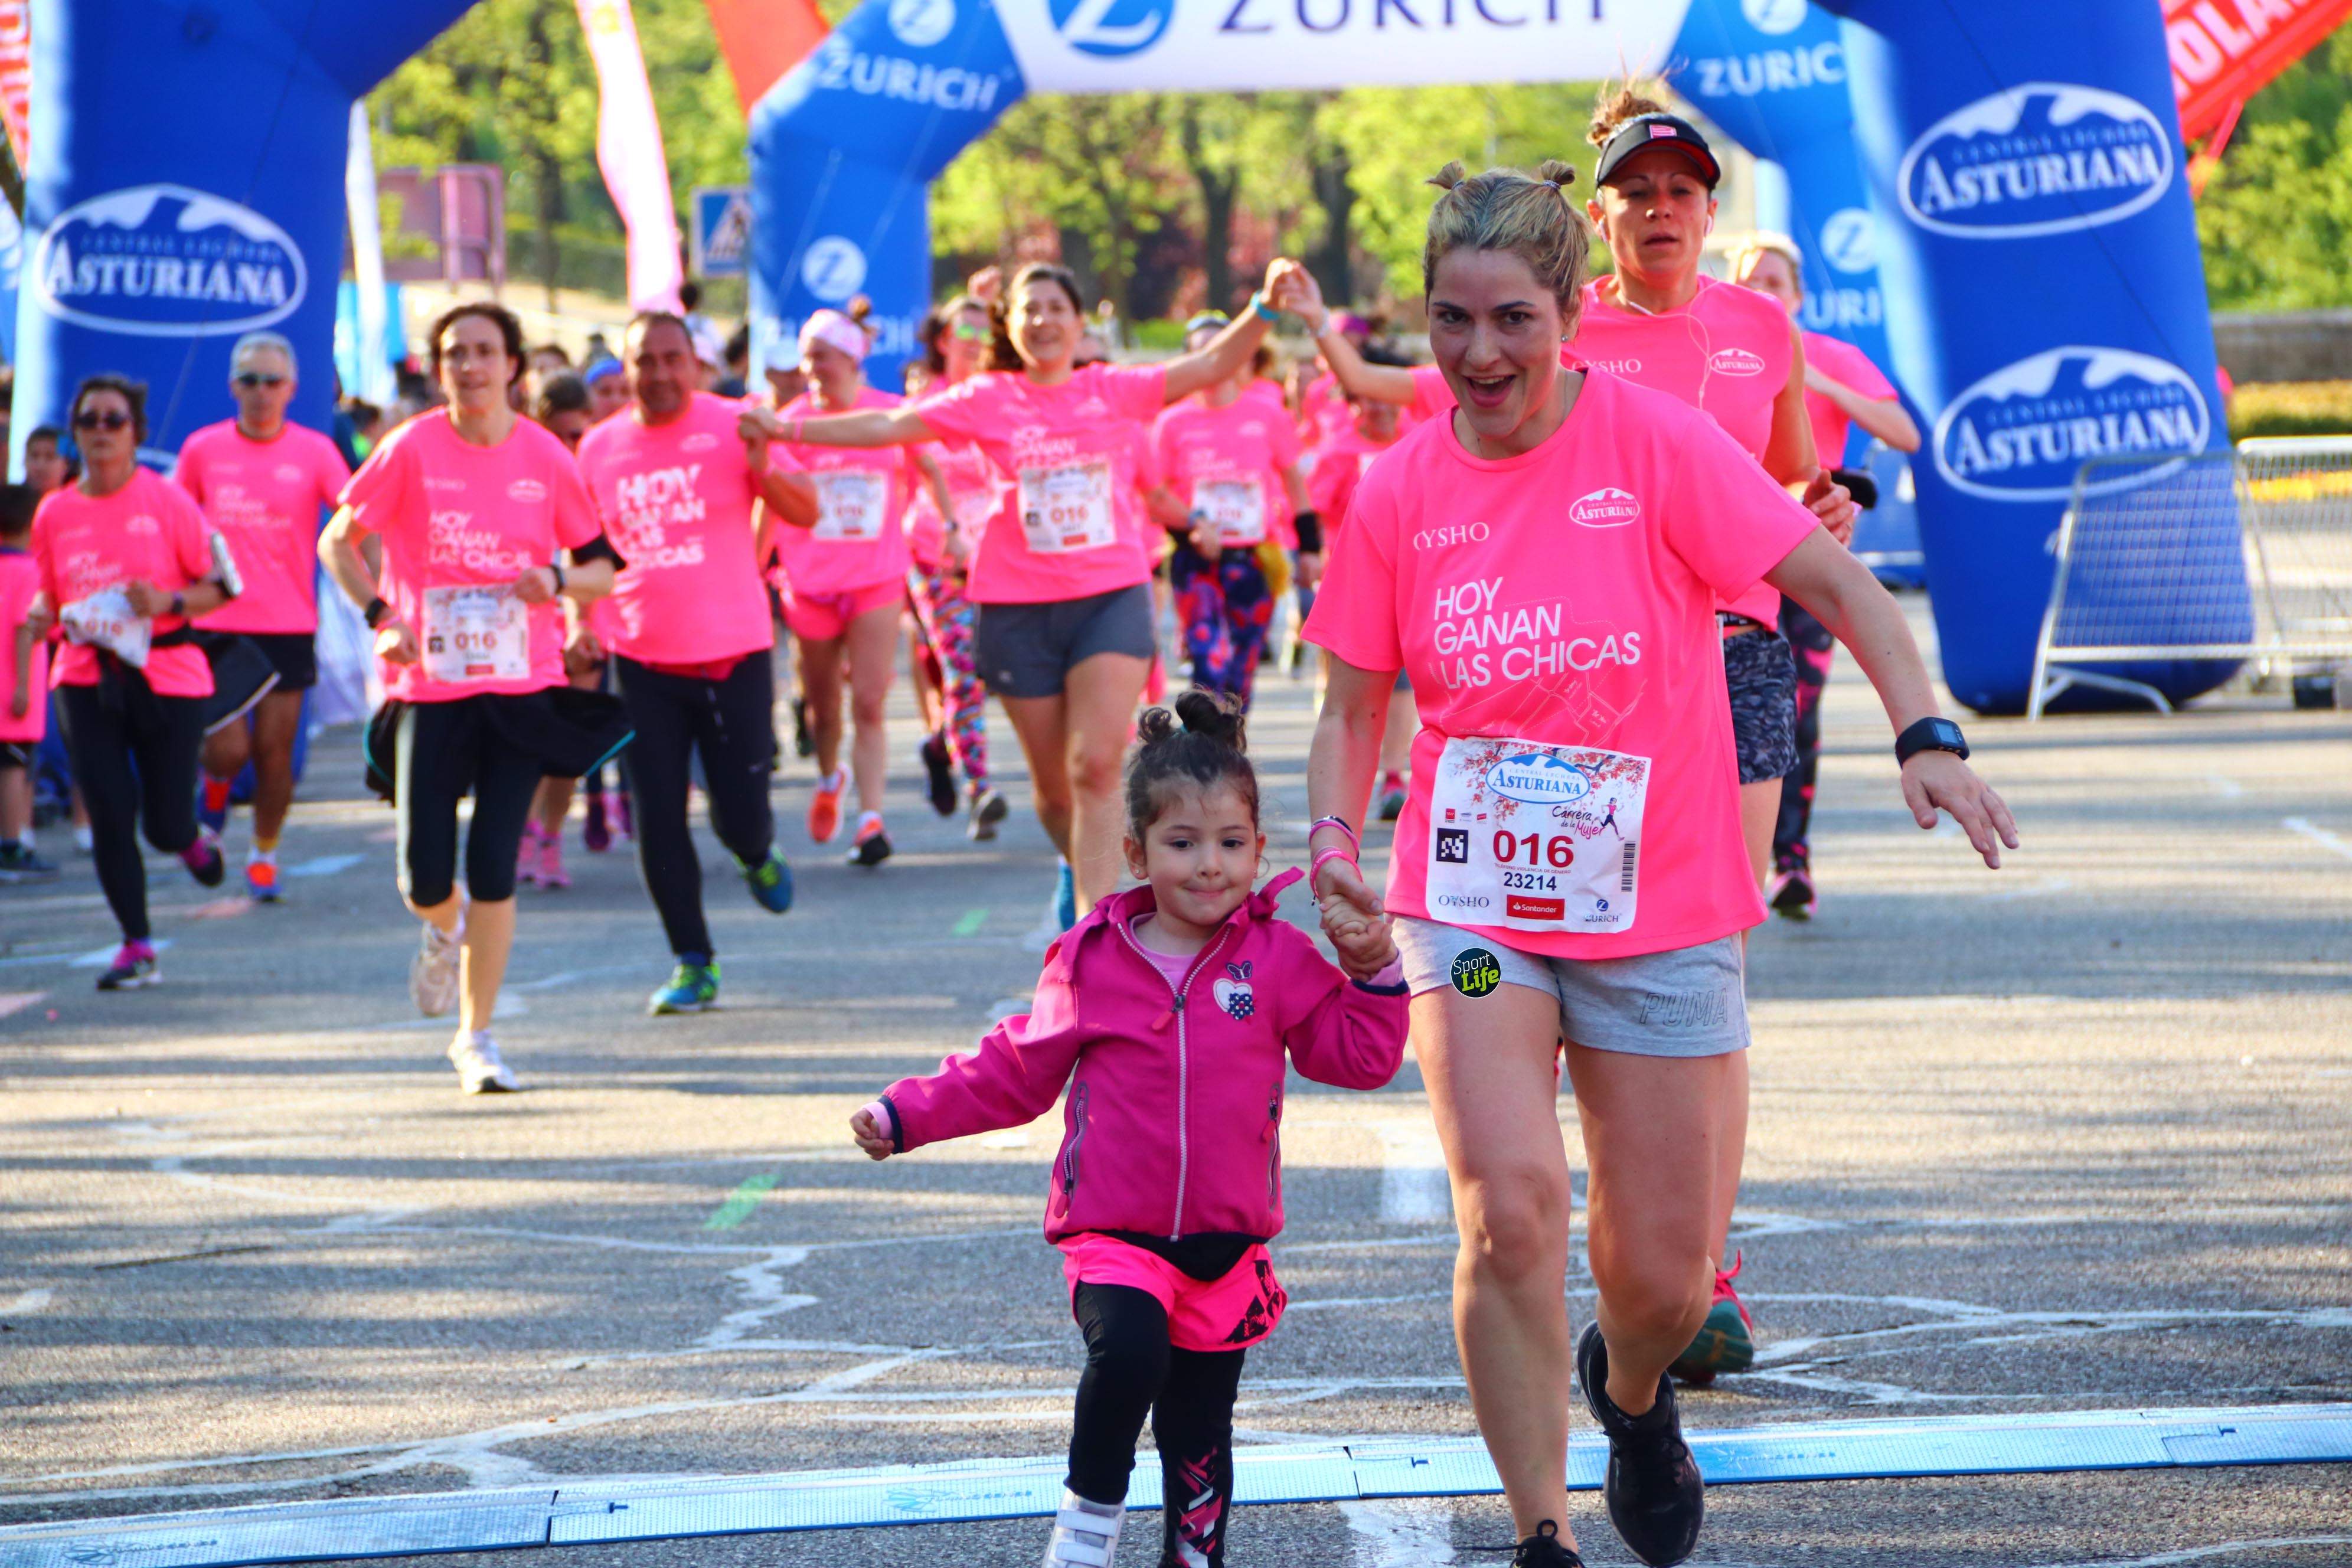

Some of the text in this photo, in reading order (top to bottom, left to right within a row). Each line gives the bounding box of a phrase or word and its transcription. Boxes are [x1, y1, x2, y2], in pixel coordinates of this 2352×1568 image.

[819, 44, 999, 112] ZURICH
[1919, 142, 2163, 215] ASTURIANA
[46, 236, 288, 307] ASTURIANA
[1953, 403, 2197, 475] ASTURIANA
[617, 463, 703, 511] HOY
[1434, 576, 1504, 620] HOY
[455, 632, 498, 651] 016
[1434, 603, 1562, 655] GANAN
[1440, 631, 1641, 690] LAS CHICAS
[1492, 768, 1581, 795] ASTURIANA
[1552, 805, 1592, 821] Carrera
[1561, 819, 1606, 839] de la Mujer
[1493, 830, 1574, 868] 016
[1504, 871, 1557, 891] 23214
[1438, 894, 1489, 908] OYSHO
[1521, 904, 1557, 913] Santander
[1639, 988, 1727, 1027] PUMA
